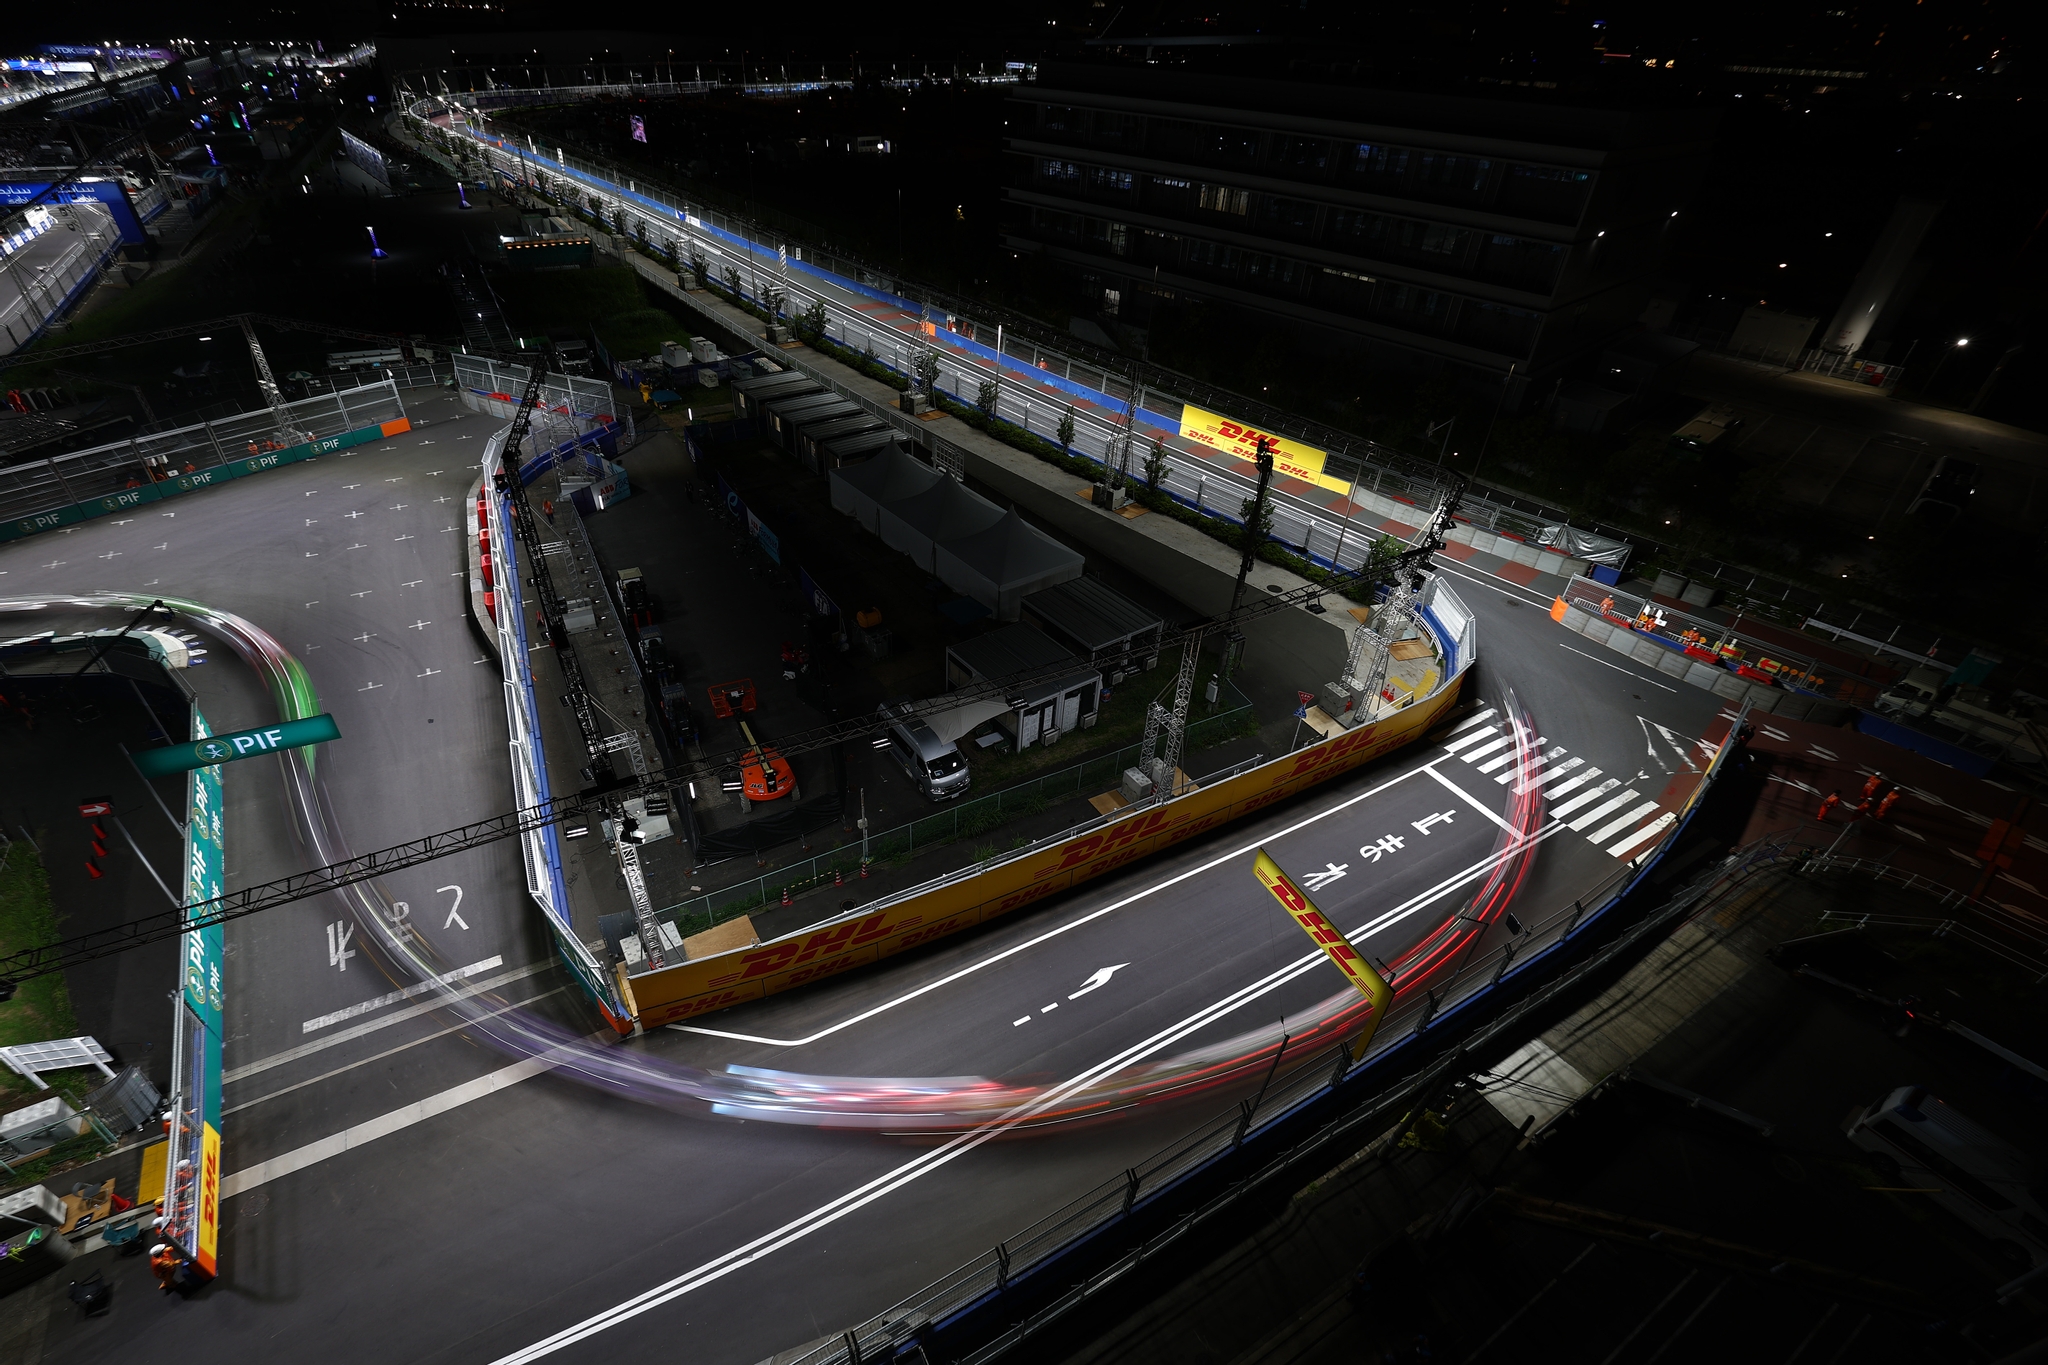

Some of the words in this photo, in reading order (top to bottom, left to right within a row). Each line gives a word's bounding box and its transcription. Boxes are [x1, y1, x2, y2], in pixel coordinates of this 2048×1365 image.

[323, 439, 340, 450] PIF
[1188, 430, 1215, 447] DHL
[1218, 421, 1282, 455] DHL
[260, 455, 279, 467] PIF
[1279, 462, 1309, 479] DHL
[192, 472, 213, 485] PIF
[117, 492, 140, 505] PIF
[35, 513, 60, 528] PIF
[231, 729, 283, 755] PIF
[1289, 726, 1382, 778] DHL
[1374, 735, 1408, 758] DHL
[1311, 760, 1349, 784] DHL
[195, 773, 209, 817] PIF
[1244, 789, 1285, 813] DHL
[212, 810, 222, 836] PIF
[1170, 817, 1214, 841] DHL
[1057, 810, 1173, 870] DHL
[1302, 809, 1457, 892] 止まれ
[191, 842, 207, 890] PIF
[1089, 849, 1140, 876] DHL
[1000, 883, 1054, 911] DHL
[901, 919, 961, 947] DHL
[1271, 875, 1357, 976] DHL
[740, 913, 895, 980] DHL
[210, 961, 221, 993] PIF
[573, 952, 602, 993] PIF
[788, 956, 857, 986] DHL
[665, 991, 740, 1020] DHL
[205, 1150, 216, 1229] DHL
